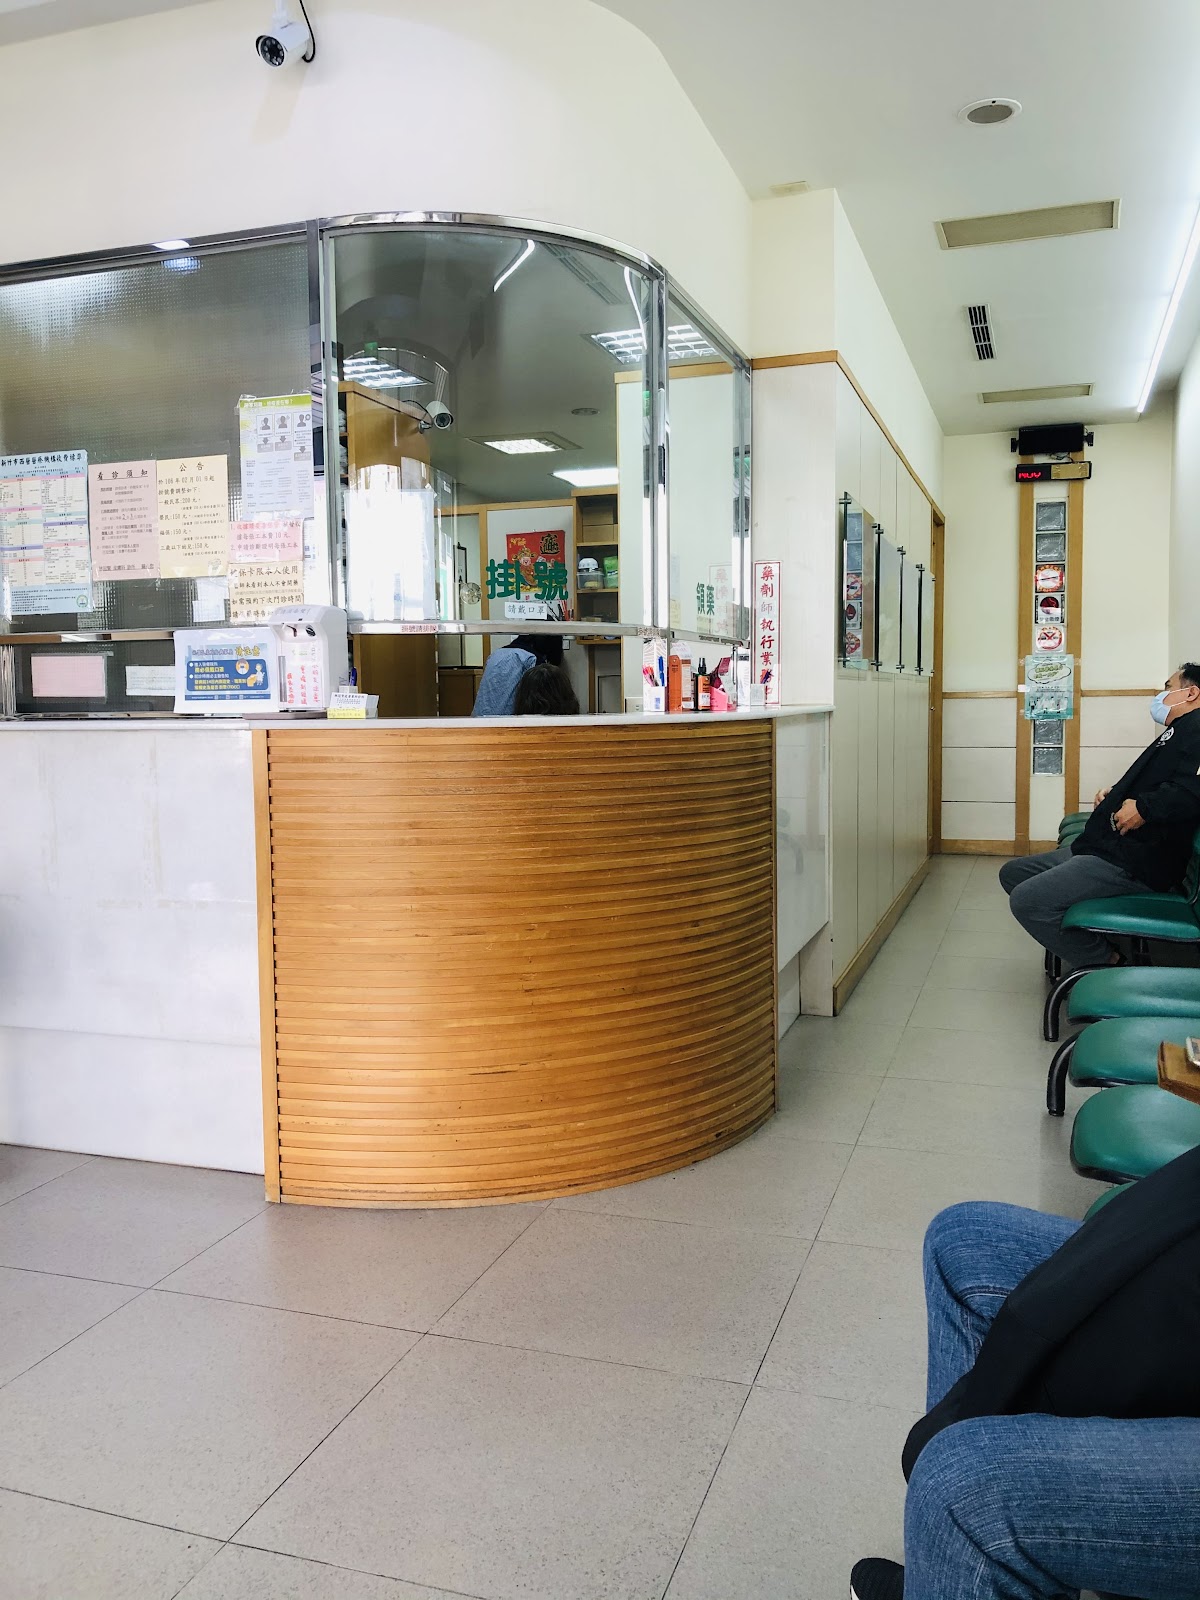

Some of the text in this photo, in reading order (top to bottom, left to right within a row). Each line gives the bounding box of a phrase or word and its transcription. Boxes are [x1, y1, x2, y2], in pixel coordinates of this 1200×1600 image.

[97, 468, 148, 481] 看診須知
[486, 558, 569, 600] 掛號
[507, 604, 546, 615] 請戴口罩
